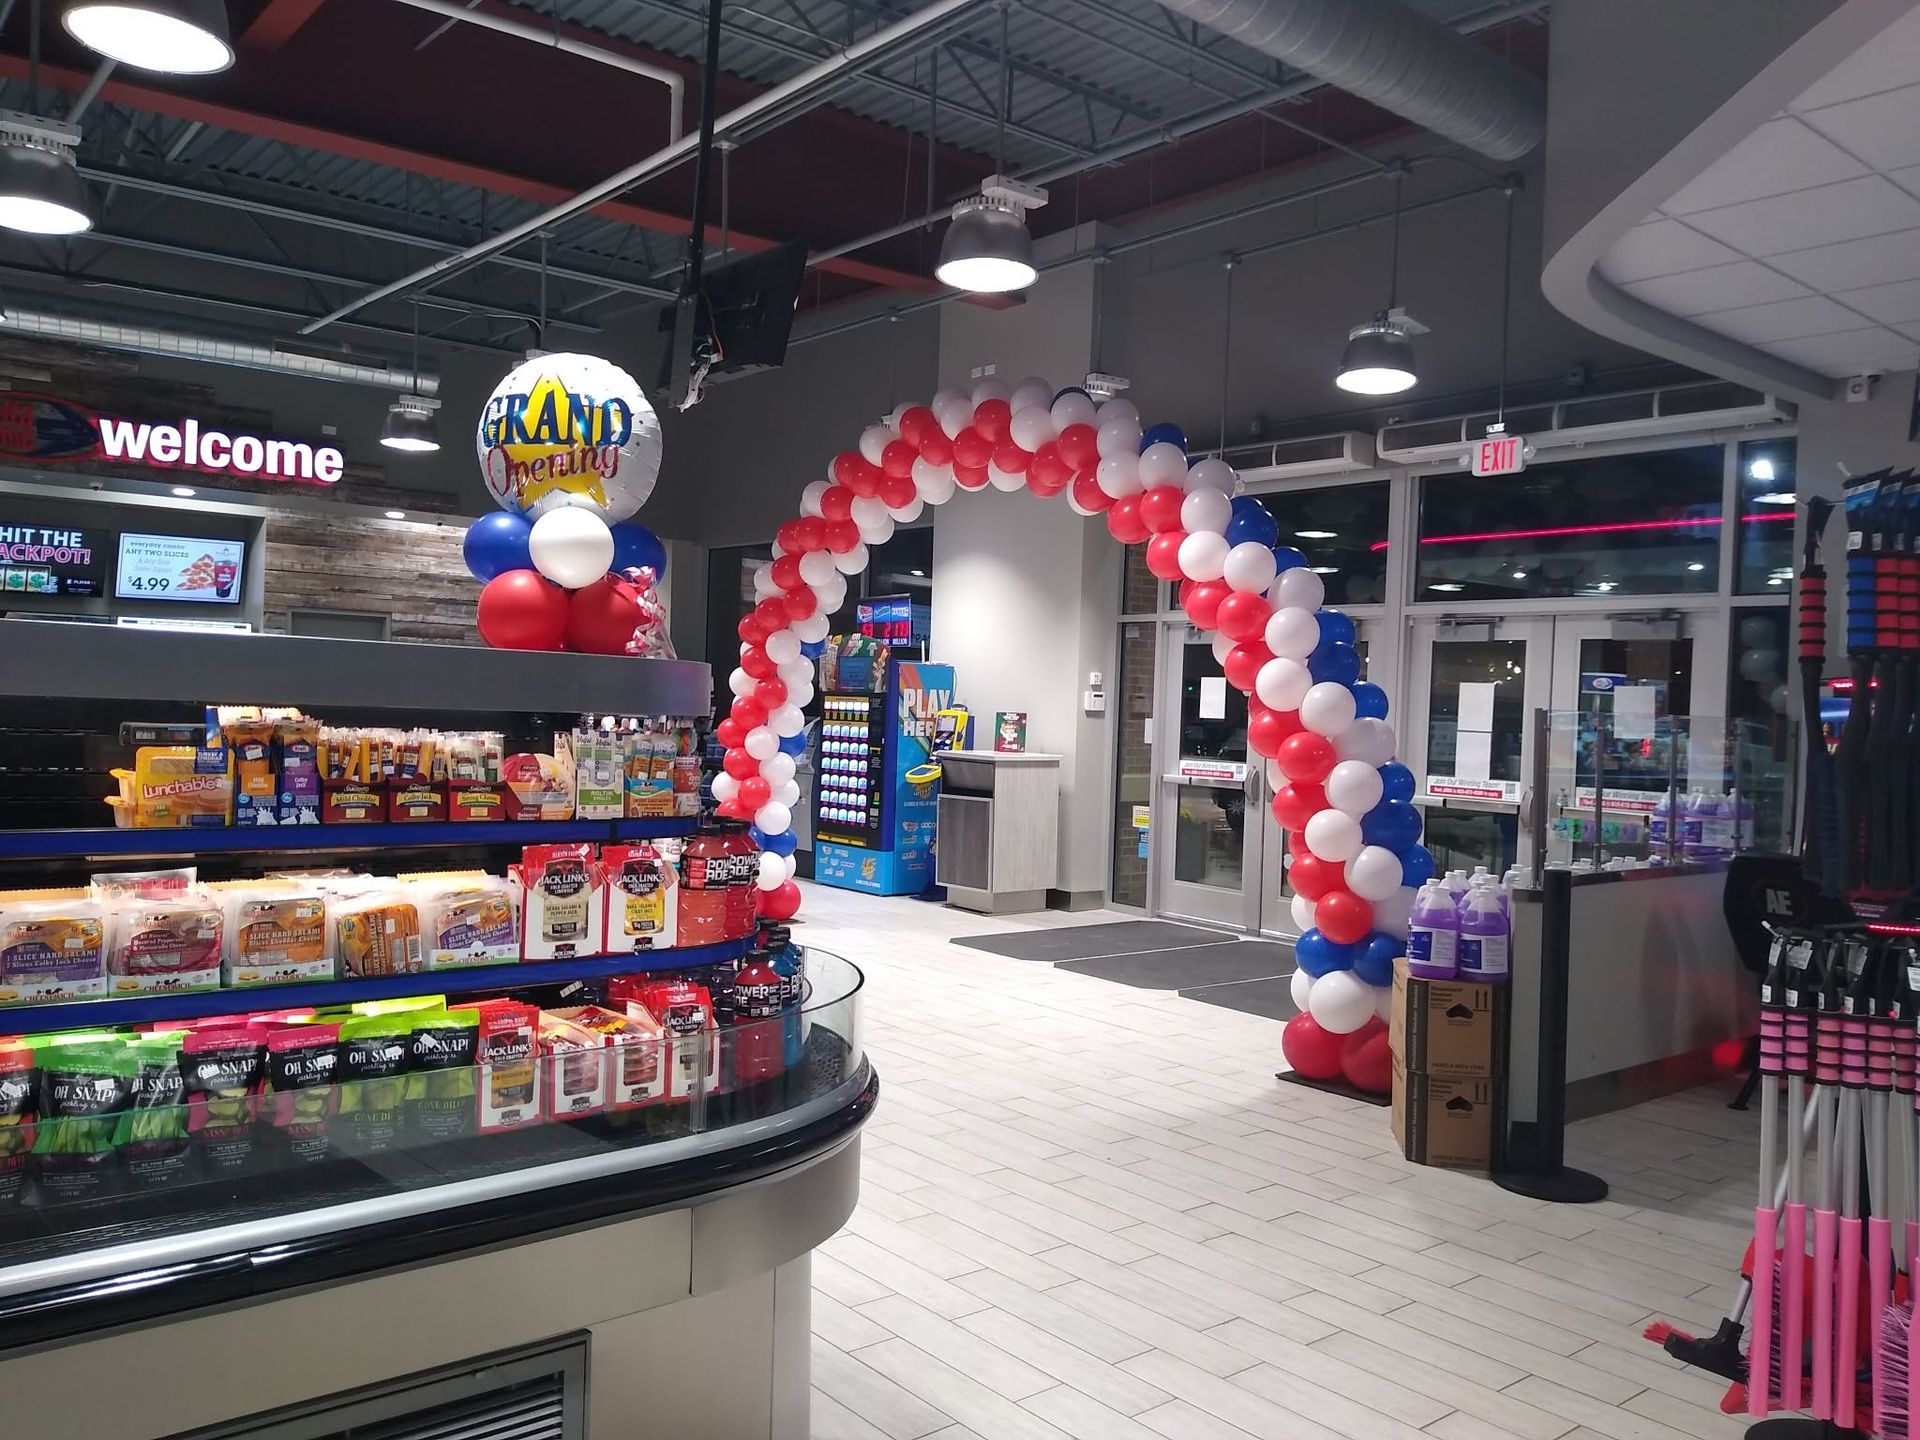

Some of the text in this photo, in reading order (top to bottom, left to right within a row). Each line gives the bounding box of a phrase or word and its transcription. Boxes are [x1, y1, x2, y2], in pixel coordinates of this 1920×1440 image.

[482, 389, 634, 448] GRAND
[99, 419, 344, 482] welcome
[1480, 439, 1517, 472] EXIT
[487, 443, 619, 498] Opening
[0, 526, 83, 547] HIT THE
[0, 543, 91, 565] ACKPOT!
[164, 550, 189, 558] SLICES
[128, 575, 170, 592] $4.99
[903, 688, 951, 718] PLAY
[903, 720, 935, 737] HER
[538, 875, 562, 886] JACK
[249, 932, 271, 940] SLICE
[13, 953, 39, 962] SLICE
[40, 951, 63, 960] HARD
[433, 1038, 470, 1053] SNAP!
[483, 1046, 507, 1058] JACK
[349, 1051, 366, 1064] OH
[221, 1059, 258, 1076] SNAP!
[284, 1061, 302, 1076] OH
[148, 1076, 183, 1092] SNAP
[54, 1085, 69, 1100] OH
